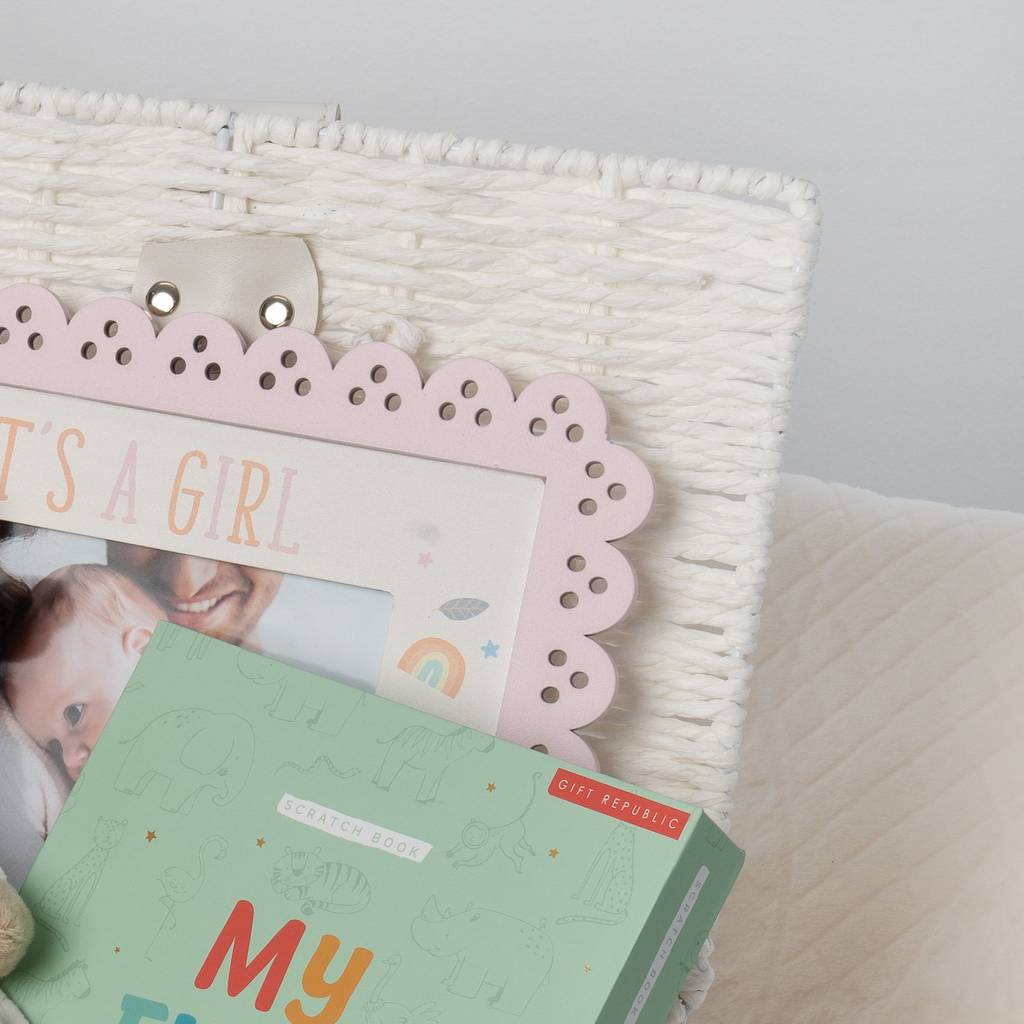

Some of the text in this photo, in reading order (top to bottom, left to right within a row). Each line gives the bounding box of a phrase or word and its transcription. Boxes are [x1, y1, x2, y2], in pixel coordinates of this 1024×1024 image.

[100, 440, 137, 524] A
[168, 450, 300, 555] GIRL
[284, 800, 421, 858] SCRATCH BOOK
[558, 779, 679, 829] GIFT REPUBLIC
